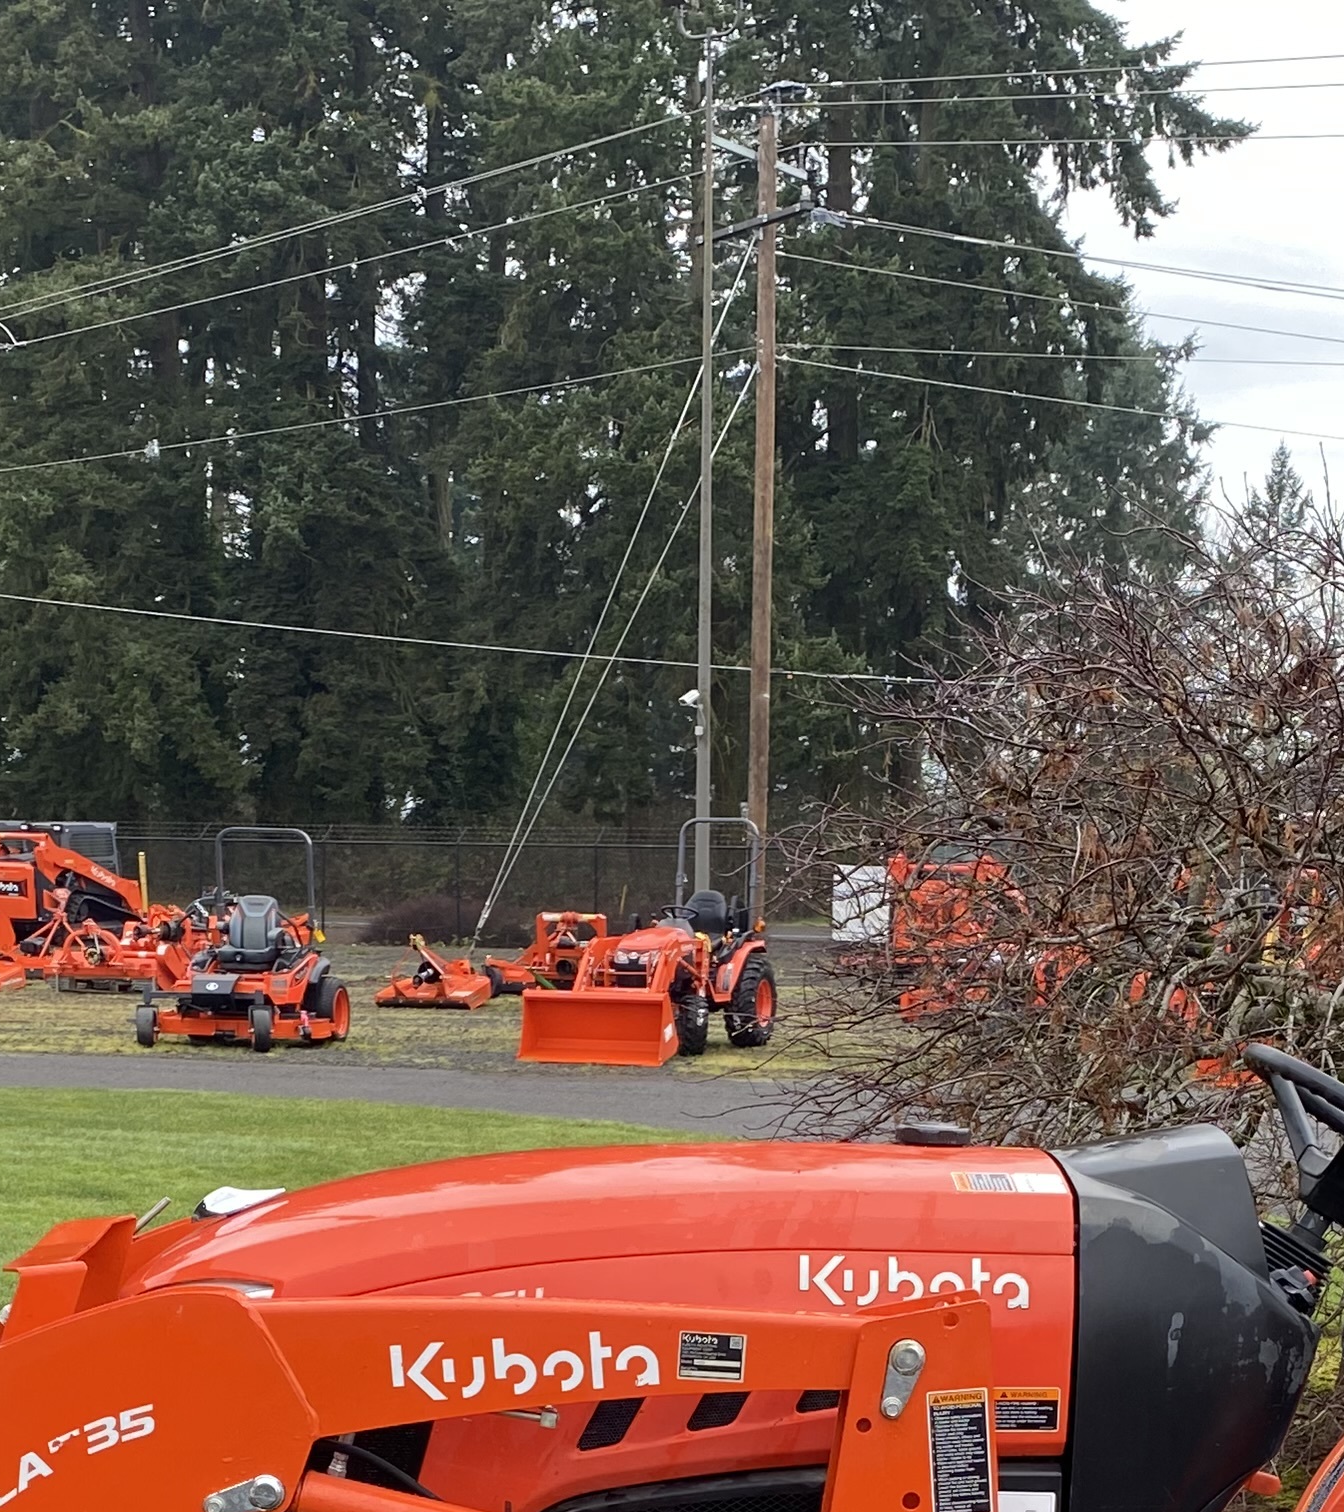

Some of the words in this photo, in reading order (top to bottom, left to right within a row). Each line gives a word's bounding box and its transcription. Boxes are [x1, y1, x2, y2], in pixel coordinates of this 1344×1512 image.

[799, 1254, 1030, 1309] Kubota
[682, 1334, 718, 1344] Kubota
[389, 1331, 660, 1400] Kubota
[939, 1393, 982, 1402] WARNING
